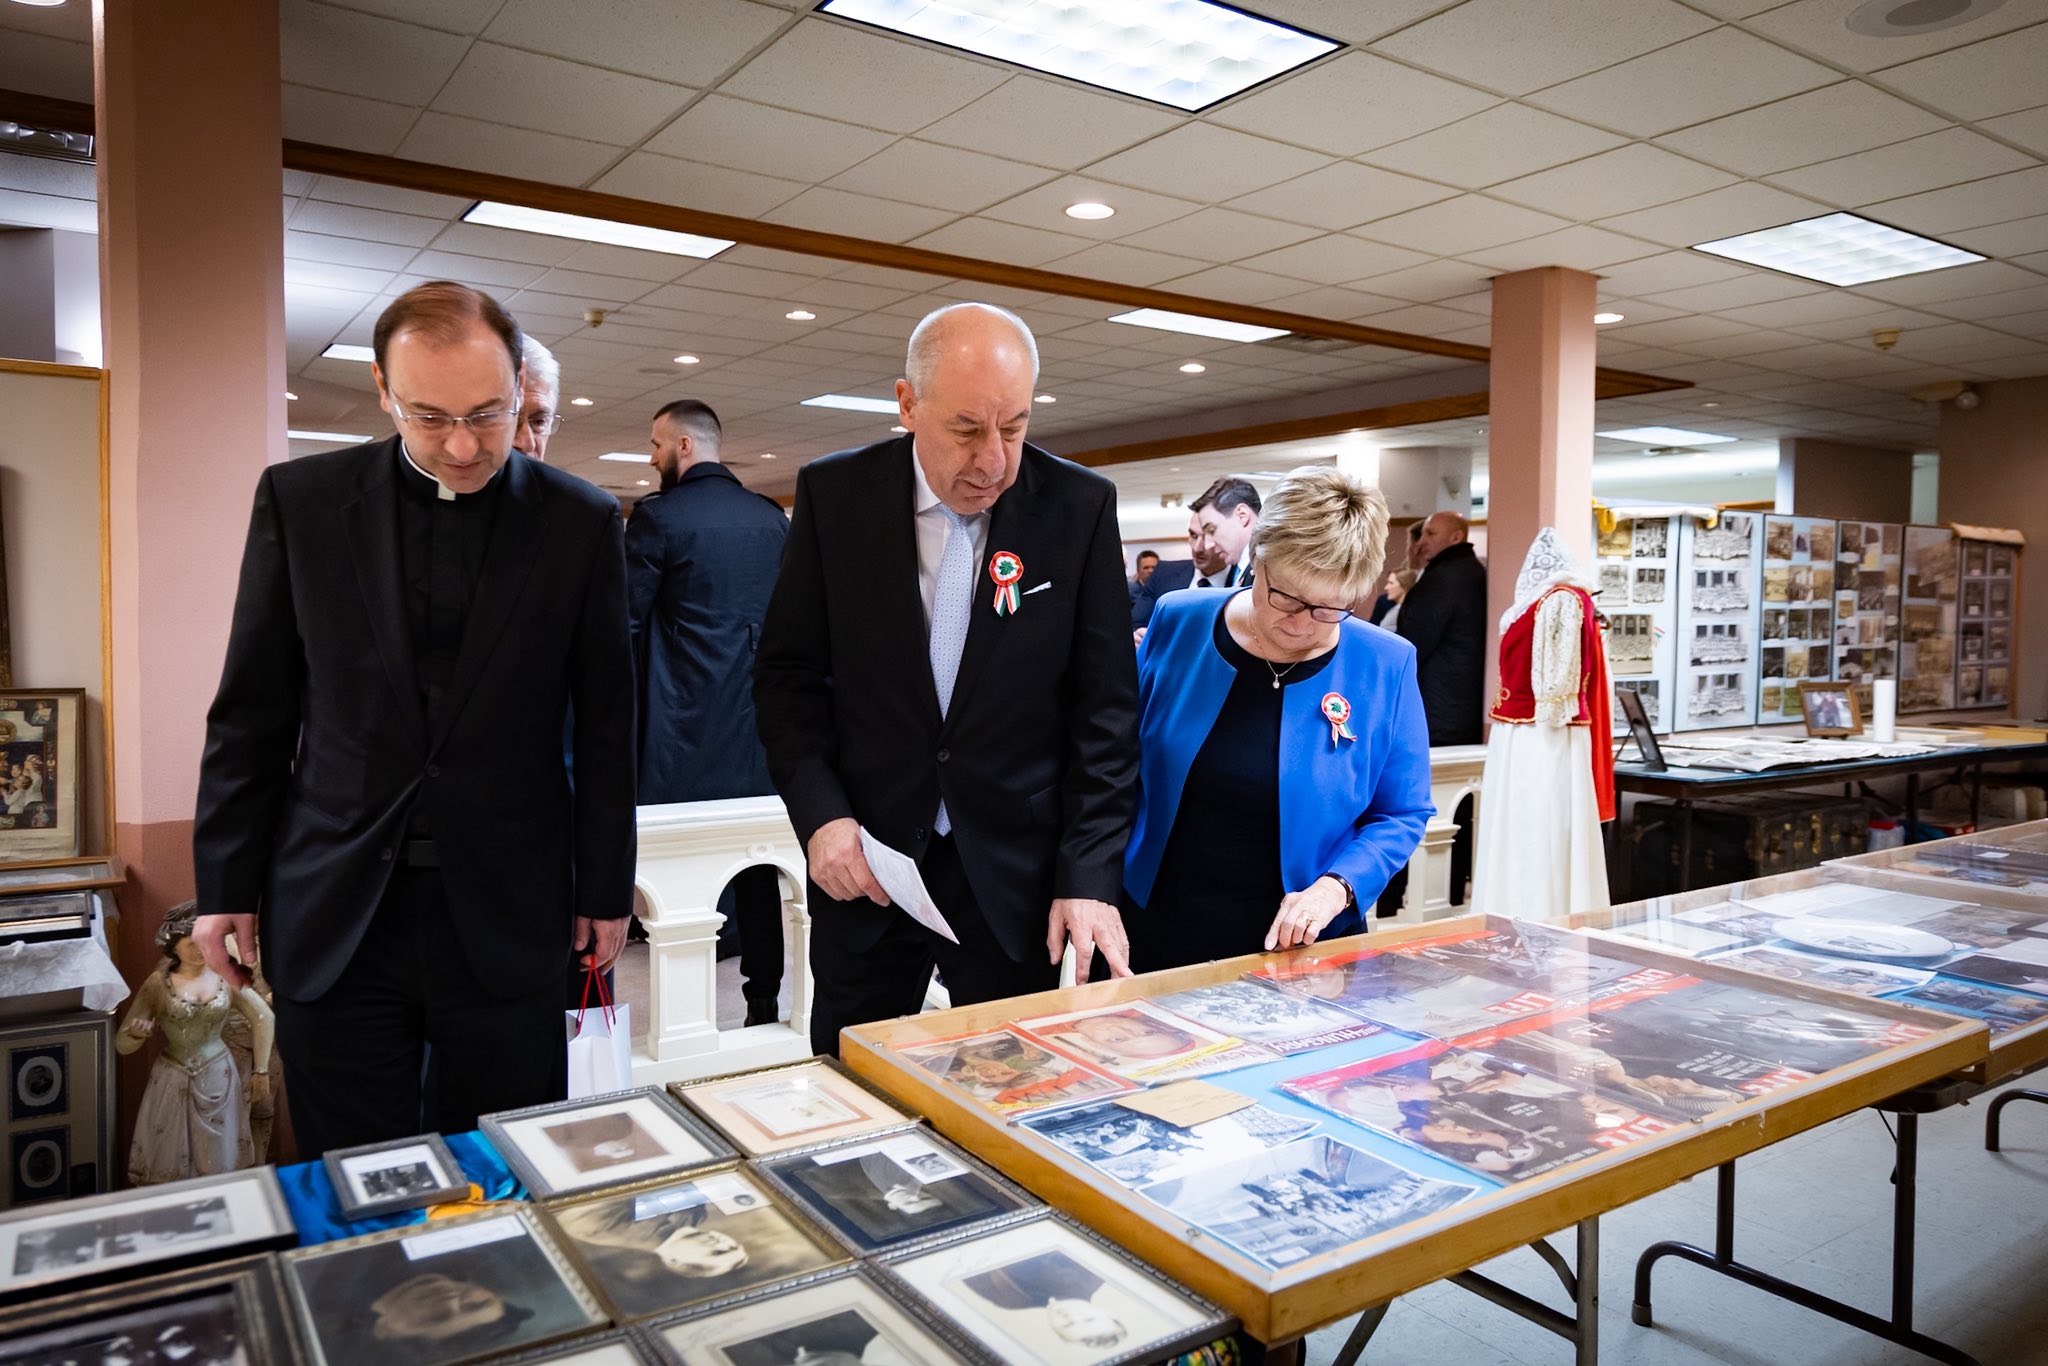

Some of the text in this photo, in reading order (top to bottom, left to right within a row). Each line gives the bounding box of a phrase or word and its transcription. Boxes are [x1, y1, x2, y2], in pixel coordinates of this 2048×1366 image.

[1486, 992, 1556, 1015] LIFE
[1268, 1028, 1363, 1052] HUNGARY
[1743, 1066, 1818, 1094] LIFE
[1595, 1116, 1673, 1147] LIFE
